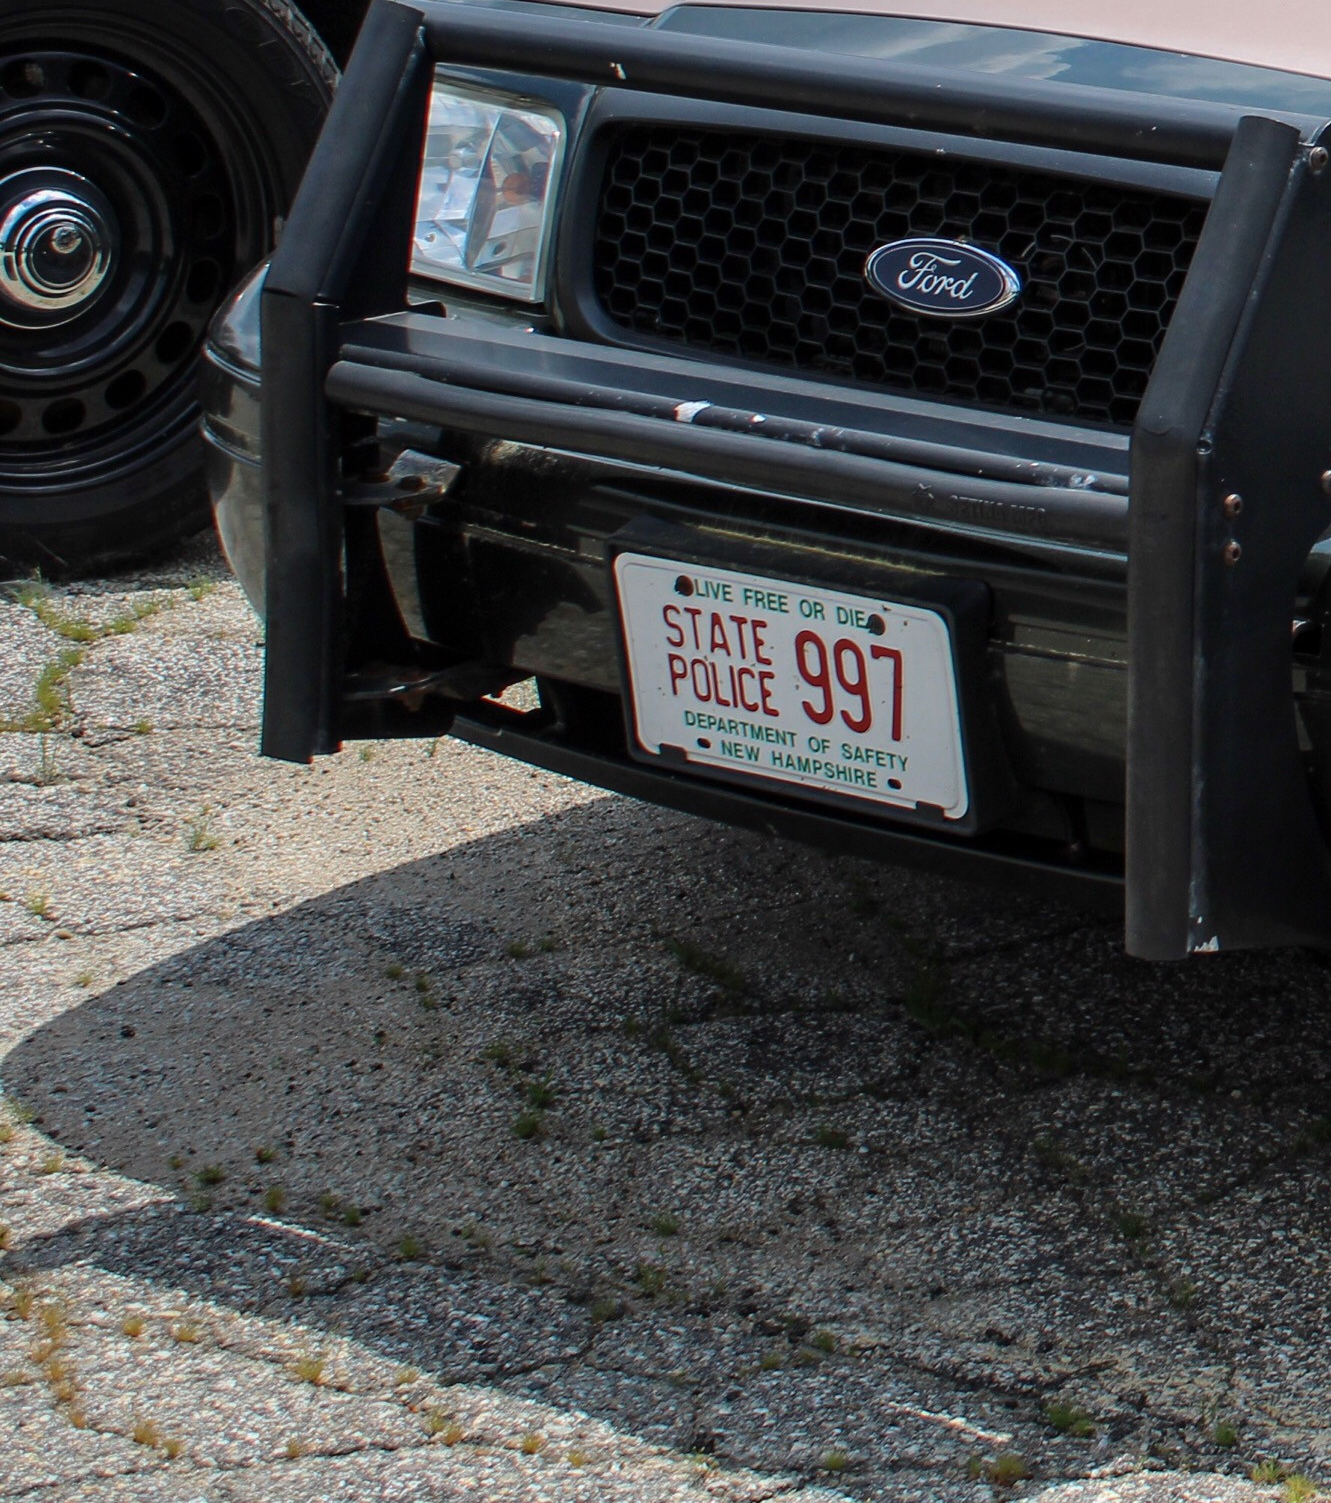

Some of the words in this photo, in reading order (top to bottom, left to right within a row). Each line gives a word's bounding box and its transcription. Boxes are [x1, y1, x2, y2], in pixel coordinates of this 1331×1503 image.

[898, 251, 978, 300] Ford
[662, 604, 773, 667] STATE
[693, 579, 733, 603] LIVE
[743, 587, 790, 615] FREE
[799, 598, 826, 622] OR
[836, 605, 868, 629] DIE
[668, 652, 780, 718] POLICE
[794, 629, 902, 742] 997
[684, 709, 798, 748] DEPARTMENT
[808, 735, 832, 756] OF
[841, 741, 909, 773] SAFETY
[720, 738, 760, 764] NEW
[771, 750, 879, 790] HAMPSHIRE
